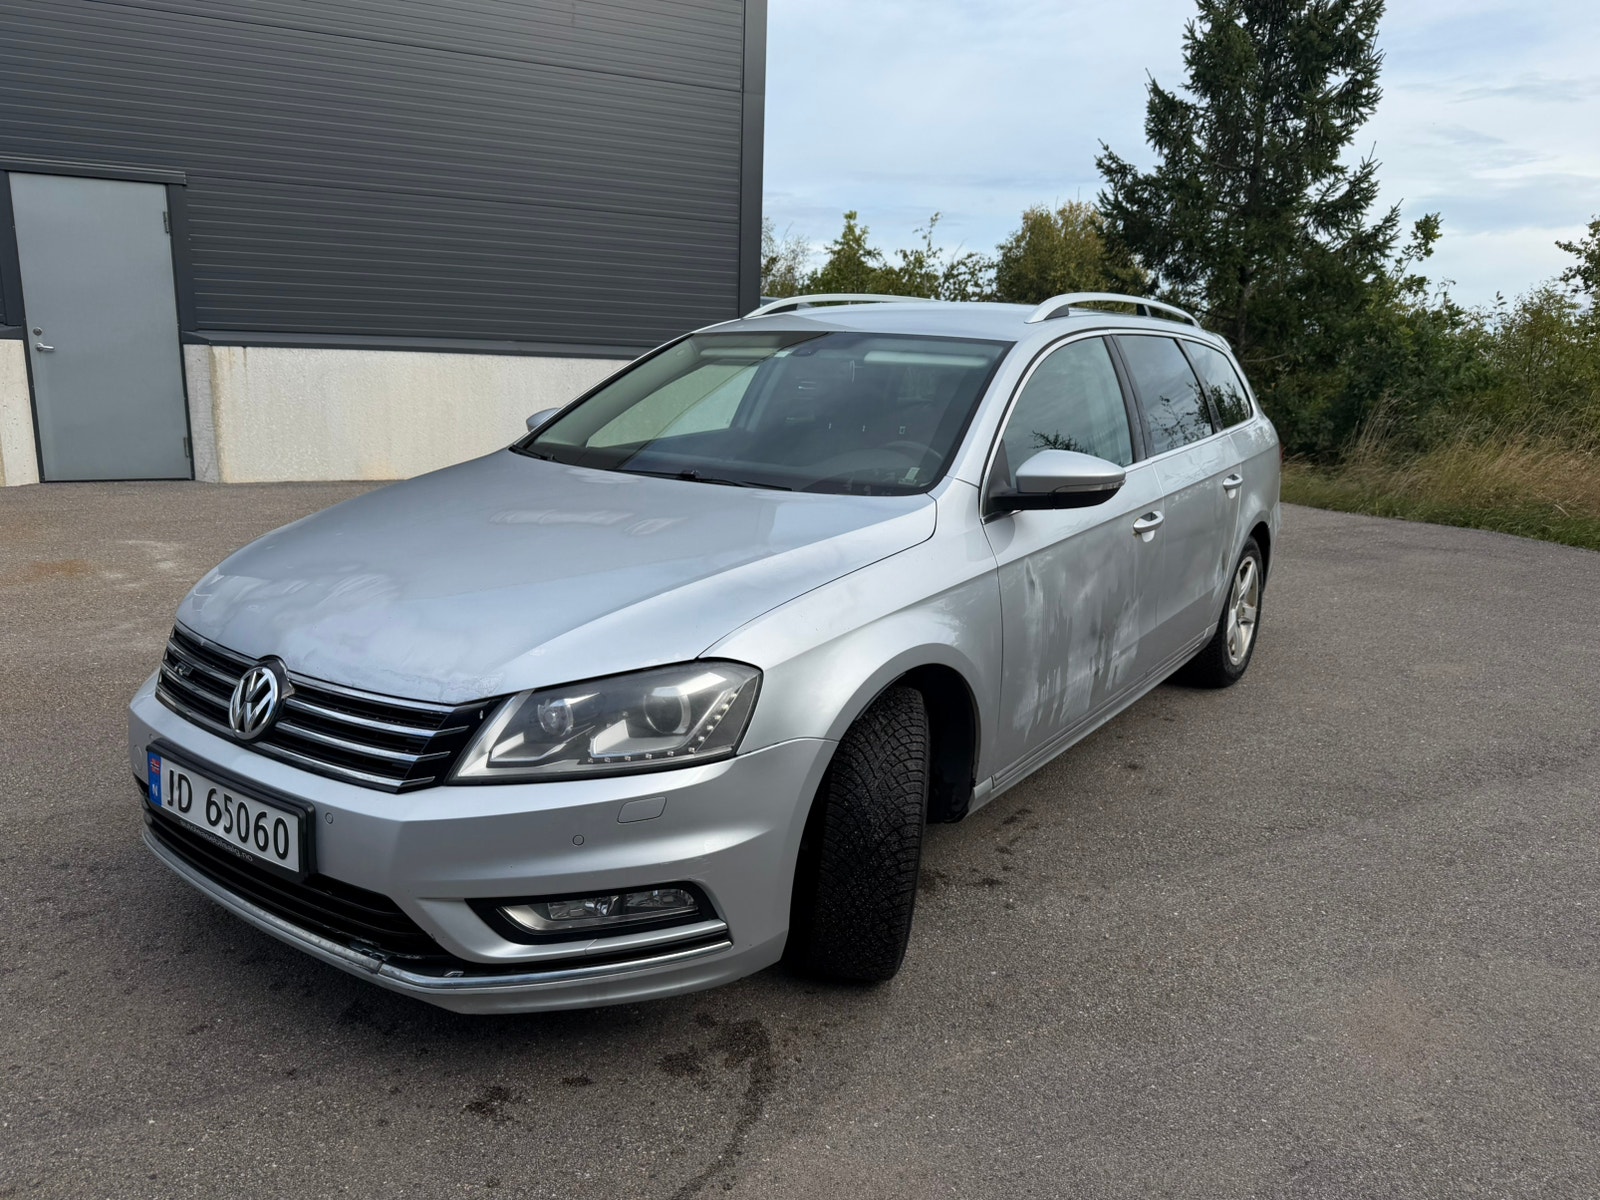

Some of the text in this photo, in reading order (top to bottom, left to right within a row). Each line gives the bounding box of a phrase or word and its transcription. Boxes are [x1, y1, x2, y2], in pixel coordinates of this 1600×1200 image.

[152, 783, 159, 797] N
[167, 769, 193, 813] JD
[206, 788, 289, 860] 65060
